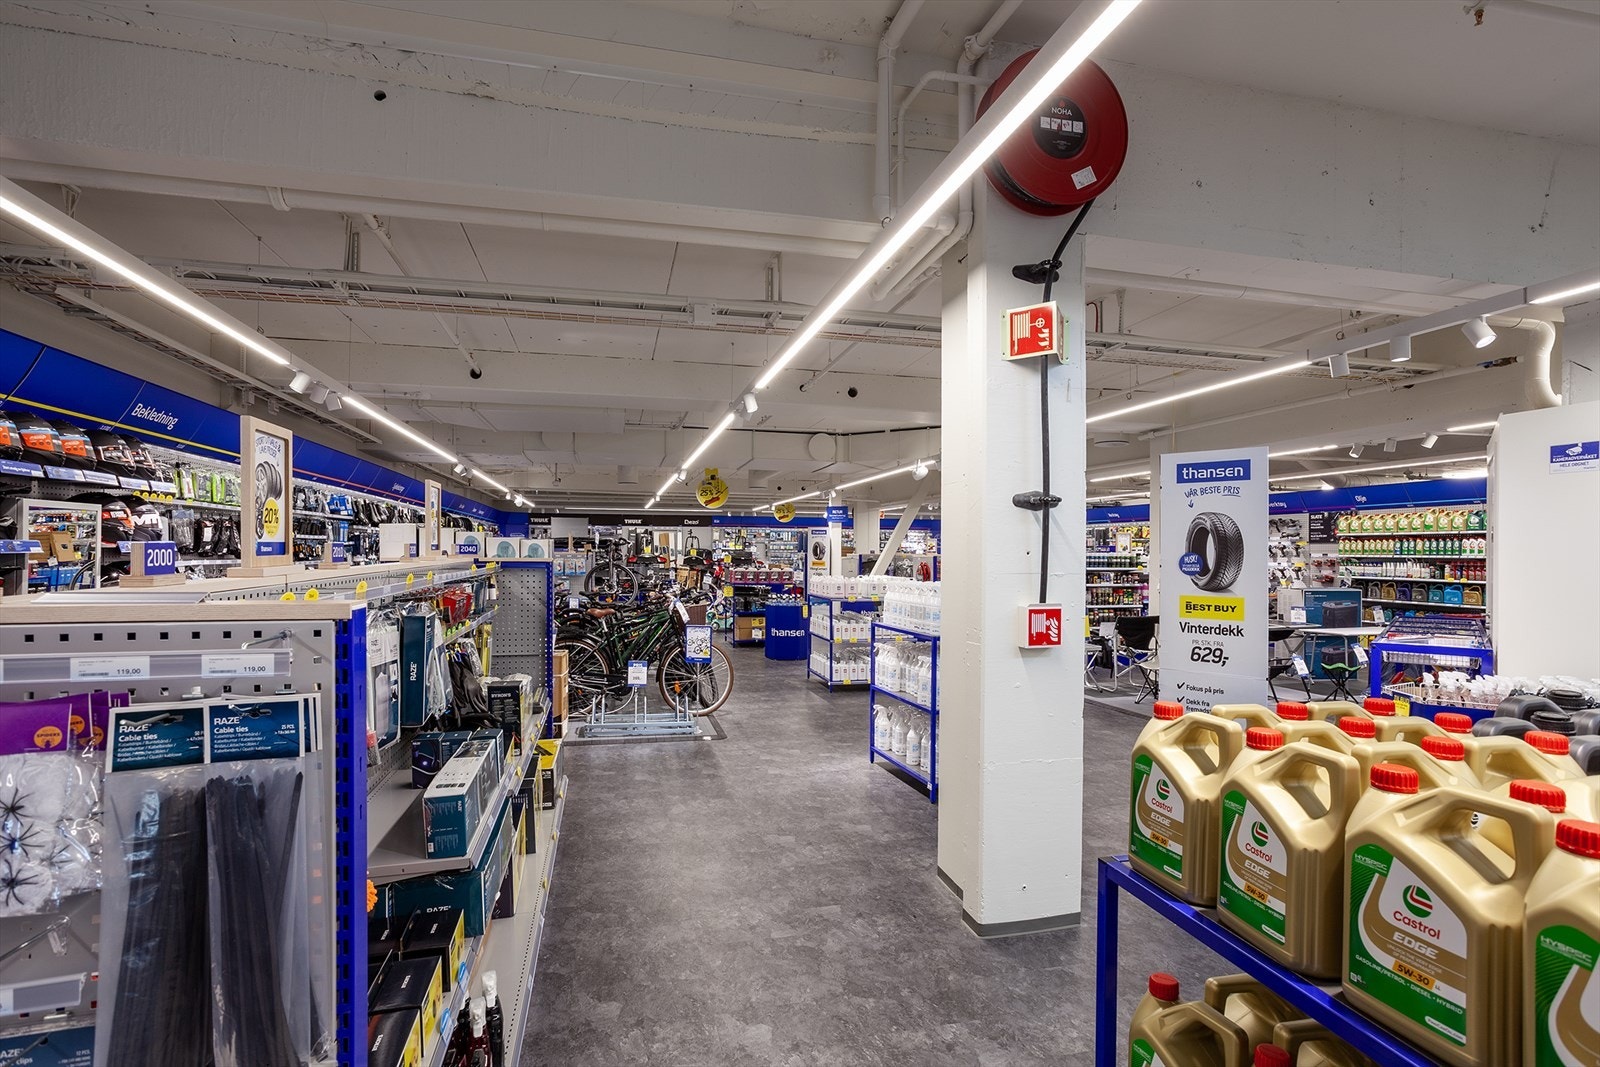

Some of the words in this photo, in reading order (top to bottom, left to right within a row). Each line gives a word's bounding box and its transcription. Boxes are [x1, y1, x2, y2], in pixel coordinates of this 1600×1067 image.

[1051, 107, 1073, 116] NOHA
[131, 403, 178, 430] Bekledning
[1182, 467, 1243, 479] thansen
[1184, 488, 1198, 498] VÅR
[1199, 486, 1221, 496] BESTE
[1222, 486, 1240, 494] PRIS
[264, 508, 279, 524] 20%
[460, 545, 477, 553] 2040
[147, 549, 173, 566] 2000
[1185, 602, 1213, 613] BEST
[1214, 605, 1237, 613] BUY
[771, 628, 805, 637] thansen
[1179, 621, 1244, 637] Vinterdekk
[1190, 646, 1229, 667] 629,-
[1186, 684, 1203, 692] Fokus
[1204, 686, 1212, 694] på
[1213, 687, 1224, 695] pris
[1186, 698, 1200, 706] Dekk
[214, 716, 240, 725] RAZE
[119, 724, 149, 734] RAZE
[1151, 798, 1173, 813] Castrol
[1151, 812, 1171, 827] EDGE
[1245, 842, 1272, 863] Castrol
[1244, 860, 1271, 879] EDGE
[1246, 885, 1266, 901] 5W-30
[1393, 911, 1441, 940] Castrol
[1392, 931, 1439, 959] EDGE
[1396, 964, 1430, 986] 5W-30
[1410, 984, 1432, 999] DIESEL
[1437, 998, 1463, 1014] HYBRID
[0, 1048, 21, 1059] AZE
[16, 1058, 33, 1066] clips
